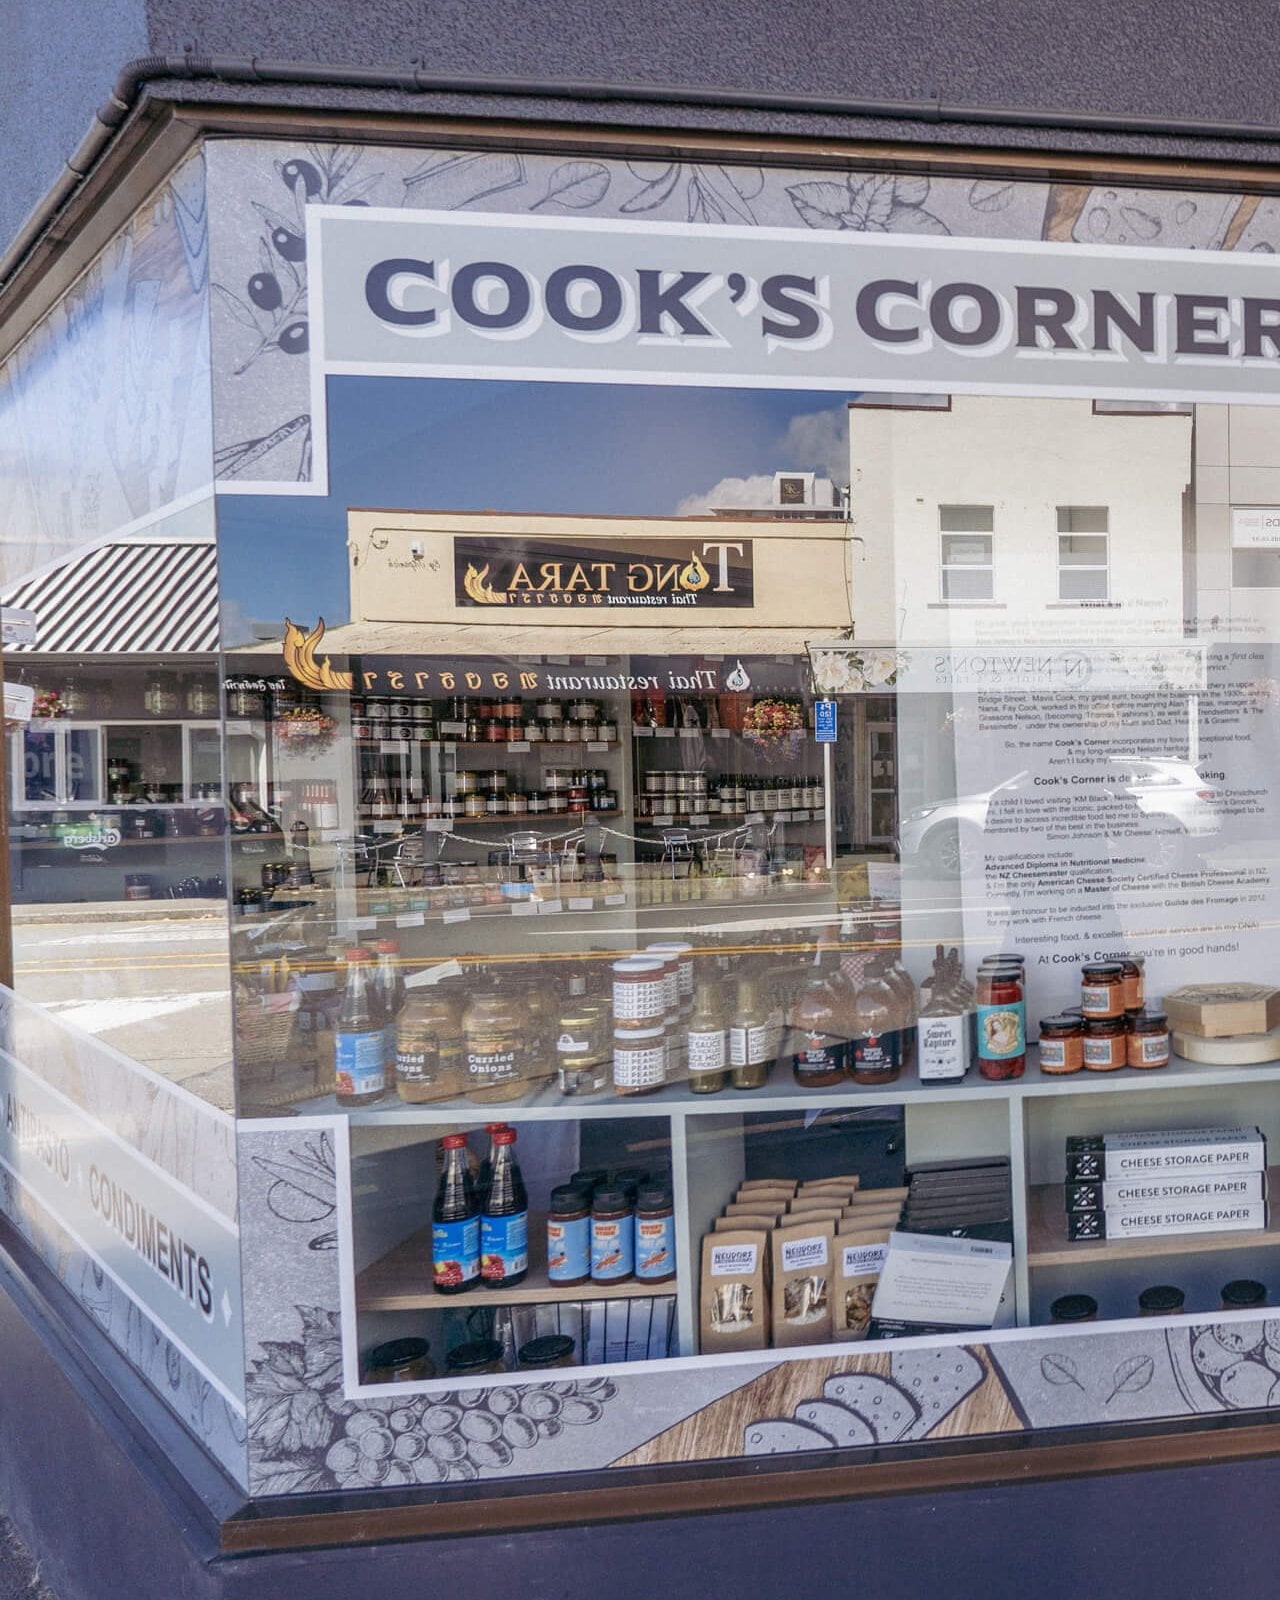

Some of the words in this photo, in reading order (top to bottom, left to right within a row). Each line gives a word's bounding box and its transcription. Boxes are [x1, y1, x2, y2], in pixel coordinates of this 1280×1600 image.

[365, 256, 826, 345] COOK'S
[1033, 776, 1068, 786] Cook's
[1071, 775, 1105, 784] Corner
[1107, 774, 1116, 783] is
[985, 863, 1025, 871] Advanced
[1027, 862, 1059, 870] Diploma
[1012, 870, 1068, 878] Cheesemaster
[1107, 875, 1135, 883] Society
[1137, 873, 1169, 881] Certified
[1171, 871, 1198, 879] Cheese
[1037, 888, 1065, 896] working
[1084, 885, 1110, 893] Master
[1121, 882, 1150, 891] Cheese
[1181, 880, 1205, 888] British
[1207, 878, 1234, 886] Cheese
[1015, 935, 1059, 944] Interesting
[1083, 932, 1090, 940] &
[1038, 955, 1049, 964] At
[1053, 952, 1090, 964] Cook's
[1094, 951, 1130, 961] Corner
[1134, 948, 1164, 959] you're
[1168, 946, 1176, 955] in
[1179, 945, 1204, 957] good
[1207, 942, 1240, 954] hands!
[926, 1029, 951, 1039] Sweet
[923, 1038, 957, 1049] Rapture
[467, 1052, 514, 1065] Curried
[469, 1063, 513, 1073] Onions
[1120, 1156, 1162, 1168] CHEESE
[1165, 1154, 1213, 1166] STORAGE
[1216, 1152, 1249, 1162] PAPER
[1118, 1187, 1159, 1199] CHEESE
[1162, 1184, 1210, 1196] STORAGE
[1214, 1182, 1247, 1192] PAPER
[1121, 1215, 1162, 1227] CHEESE
[1165, 1212, 1213, 1224] STORAGE
[1216, 1209, 1250, 1220] PAPER
[89, 1164, 213, 1315] CONDIMENTS
[785, 1243, 823, 1255] NEUDORF
[846, 1249, 883, 1260] NEUDORF
[714, 1251, 753, 1260] NEUDORF
